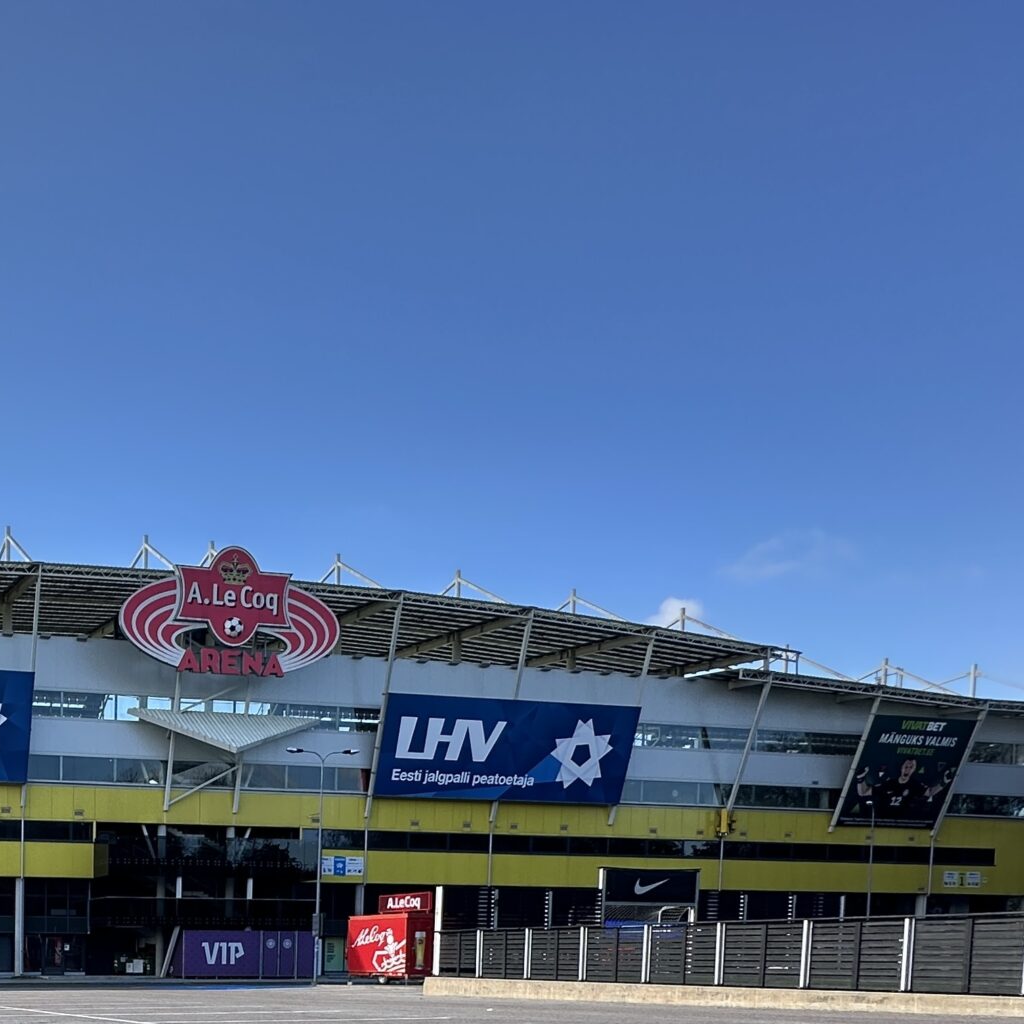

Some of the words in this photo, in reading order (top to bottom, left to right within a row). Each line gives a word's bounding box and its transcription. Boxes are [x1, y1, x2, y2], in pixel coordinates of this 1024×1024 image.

[178, 647, 284, 677] ARENA
[395, 716, 507, 762] LHV
[878, 732, 924, 746] MÄNGUKS
[924, 736, 958, 748] VALMIS
[391, 768, 422, 782] Eesti
[423, 770, 471, 786] jalgpalli
[472, 773, 535, 788] peatoetaja
[201, 942, 245, 965] VIP
